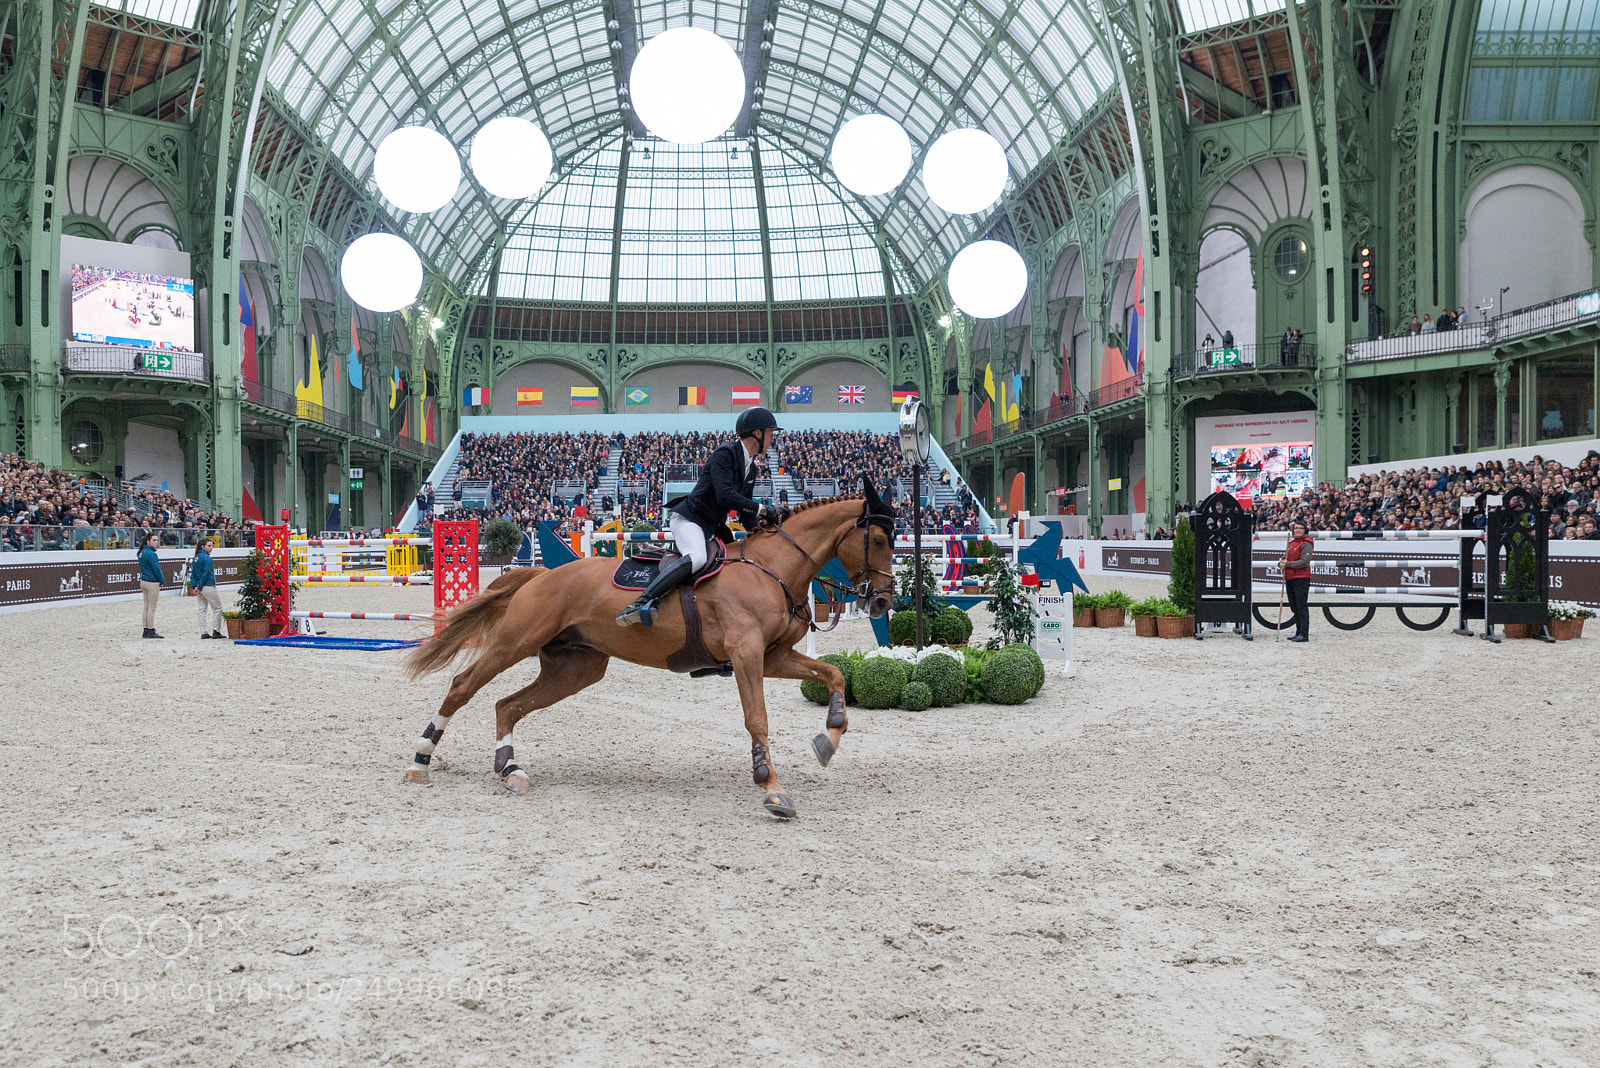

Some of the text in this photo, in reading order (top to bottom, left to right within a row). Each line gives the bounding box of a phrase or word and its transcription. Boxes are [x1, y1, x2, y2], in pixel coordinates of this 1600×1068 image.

[1345, 567, 1369, 577] PARIS
[6, 580, 31, 591] PARIS
[1038, 596, 1065, 604] FINISH
[305, 619, 311, 633] 8
